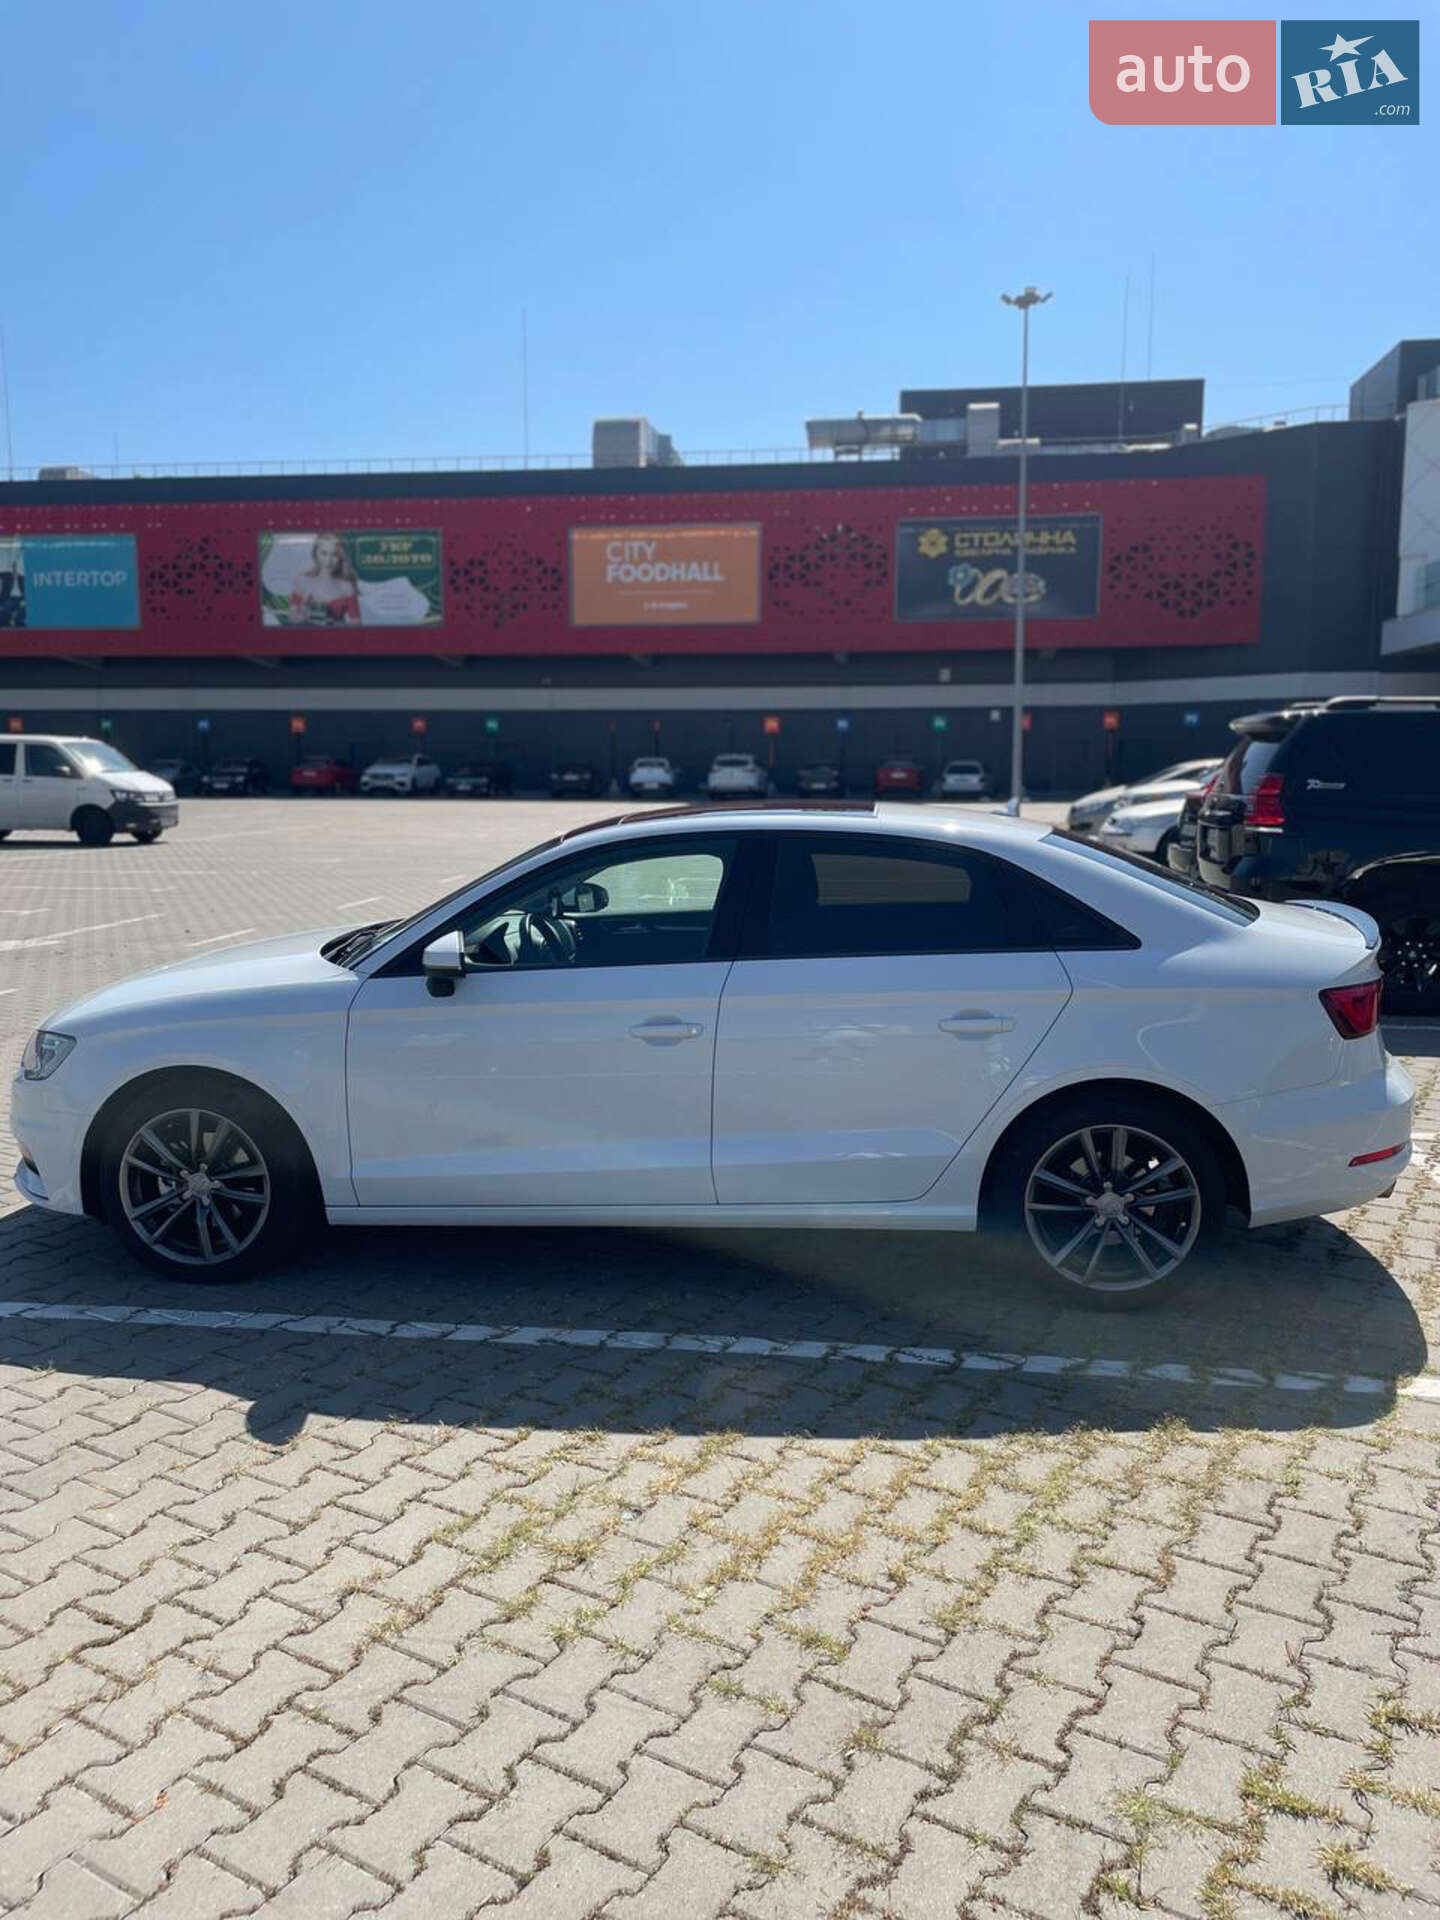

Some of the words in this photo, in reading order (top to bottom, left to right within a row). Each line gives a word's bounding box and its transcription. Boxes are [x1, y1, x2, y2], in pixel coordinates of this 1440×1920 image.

[605, 541, 657, 562] CITY
[32, 570, 127, 588] INTERTOP
[606, 562, 725, 582] FOODHALL
